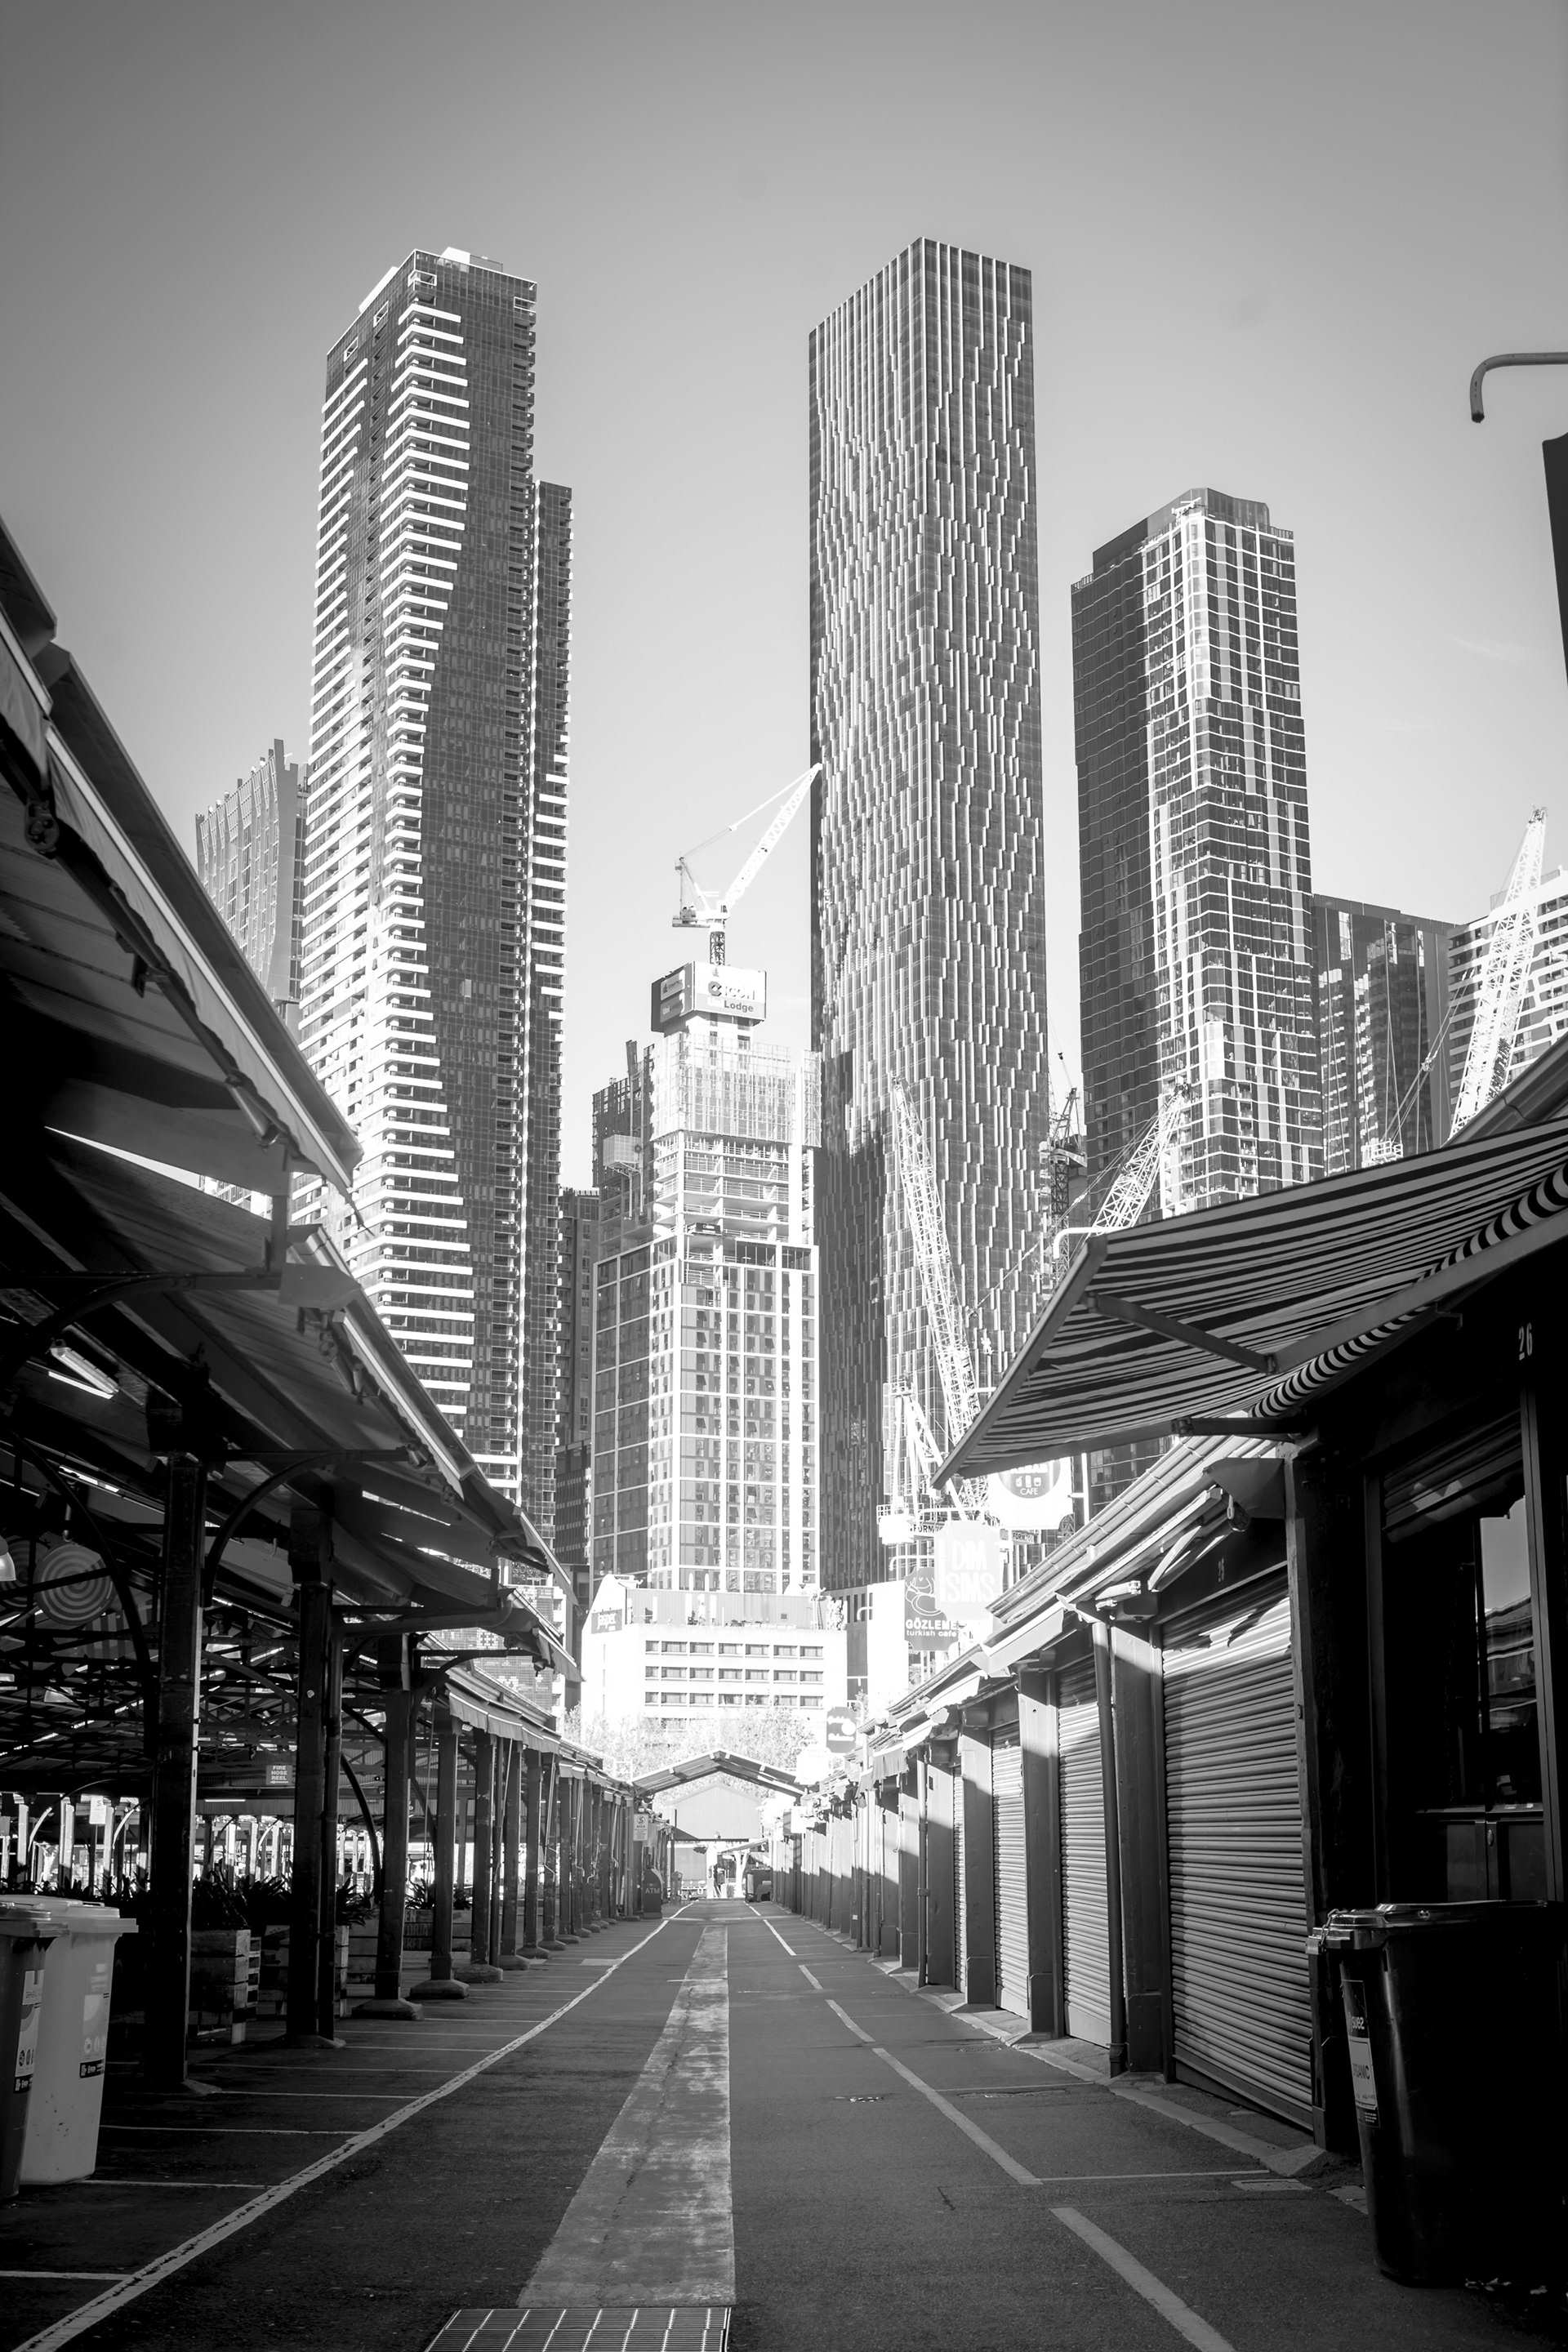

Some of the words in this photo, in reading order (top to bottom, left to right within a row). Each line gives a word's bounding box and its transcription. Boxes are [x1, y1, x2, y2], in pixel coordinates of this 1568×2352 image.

[707, 996, 755, 1013] UniLodge
[1518, 1321, 1534, 1361] 26
[1020, 1487, 1039, 1495] CAFE
[952, 1540, 987, 1570] DIM
[947, 1571, 996, 1603] SIMS
[906, 1618, 957, 1629] GÖZLEME
[1352, 2014, 1365, 2030] suez
